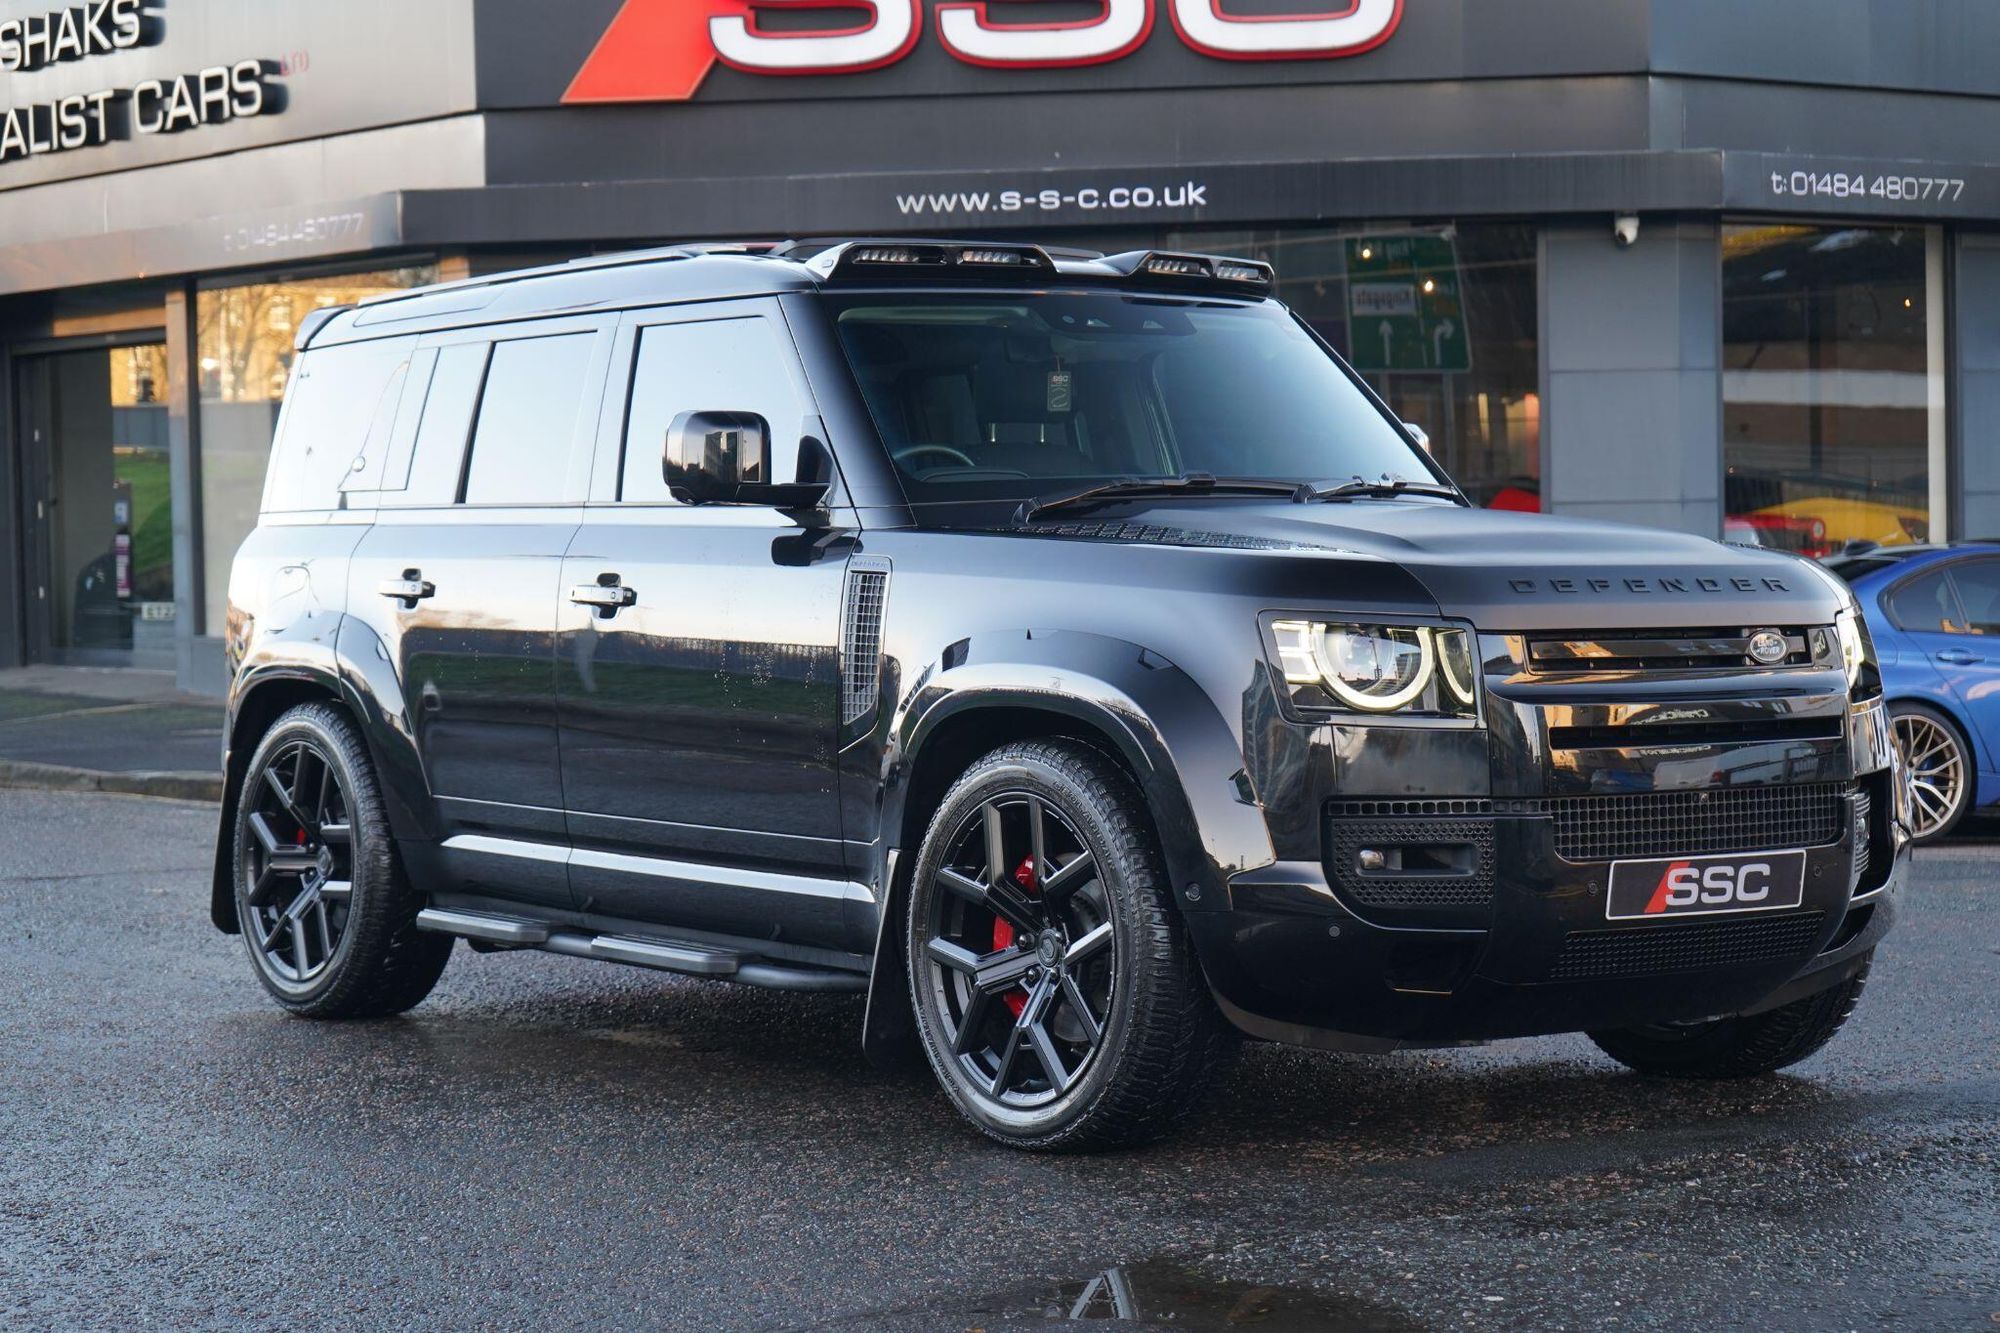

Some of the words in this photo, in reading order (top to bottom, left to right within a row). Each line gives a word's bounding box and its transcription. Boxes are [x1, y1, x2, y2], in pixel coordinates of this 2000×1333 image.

[133, 59, 262, 133] CARS
[896, 181, 1206, 214] www.s-s-c.co.uk
[1508, 577, 1790, 593] DEFENDER
[1760, 646, 1780, 655] ROVER
[1665, 863, 1771, 906] SSC
